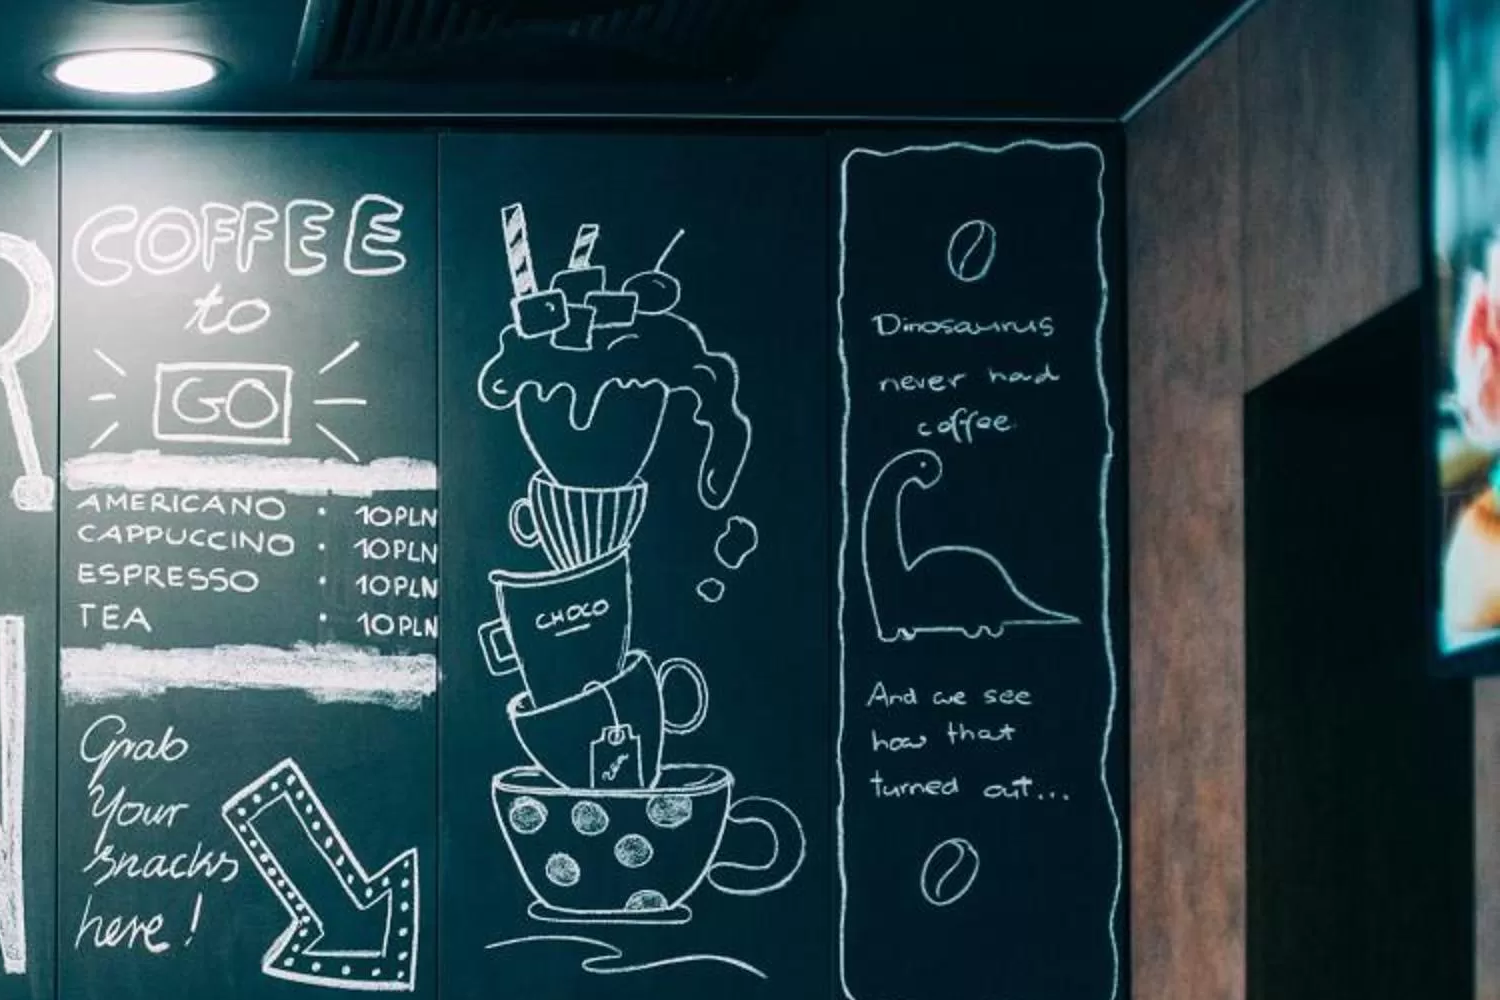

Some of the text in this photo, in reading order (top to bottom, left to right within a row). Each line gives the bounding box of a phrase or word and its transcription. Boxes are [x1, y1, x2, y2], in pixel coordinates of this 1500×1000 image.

[73, 194, 407, 286] COFFEE
[184, 283, 271, 334] to
[871, 312, 1055, 337] Dinosaurus
[879, 362, 1061, 392] never had
[172, 376, 280, 428] GO
[917, 407, 1013, 443] coffee
[75, 492, 287, 521] AMERICANO
[76, 523, 296, 557] CAPPUCCINO
[77, 562, 260, 593] ESPRESSO
[79, 603, 153, 633] TEA
[535, 598, 611, 631] CHOCO
[865, 680, 1033, 708] And we see
[79, 714, 190, 788] Grab
[871, 720, 1017, 751] how that
[869, 769, 960, 798] turned
[88, 783, 190, 853] Your
[83, 840, 241, 883] snacks
